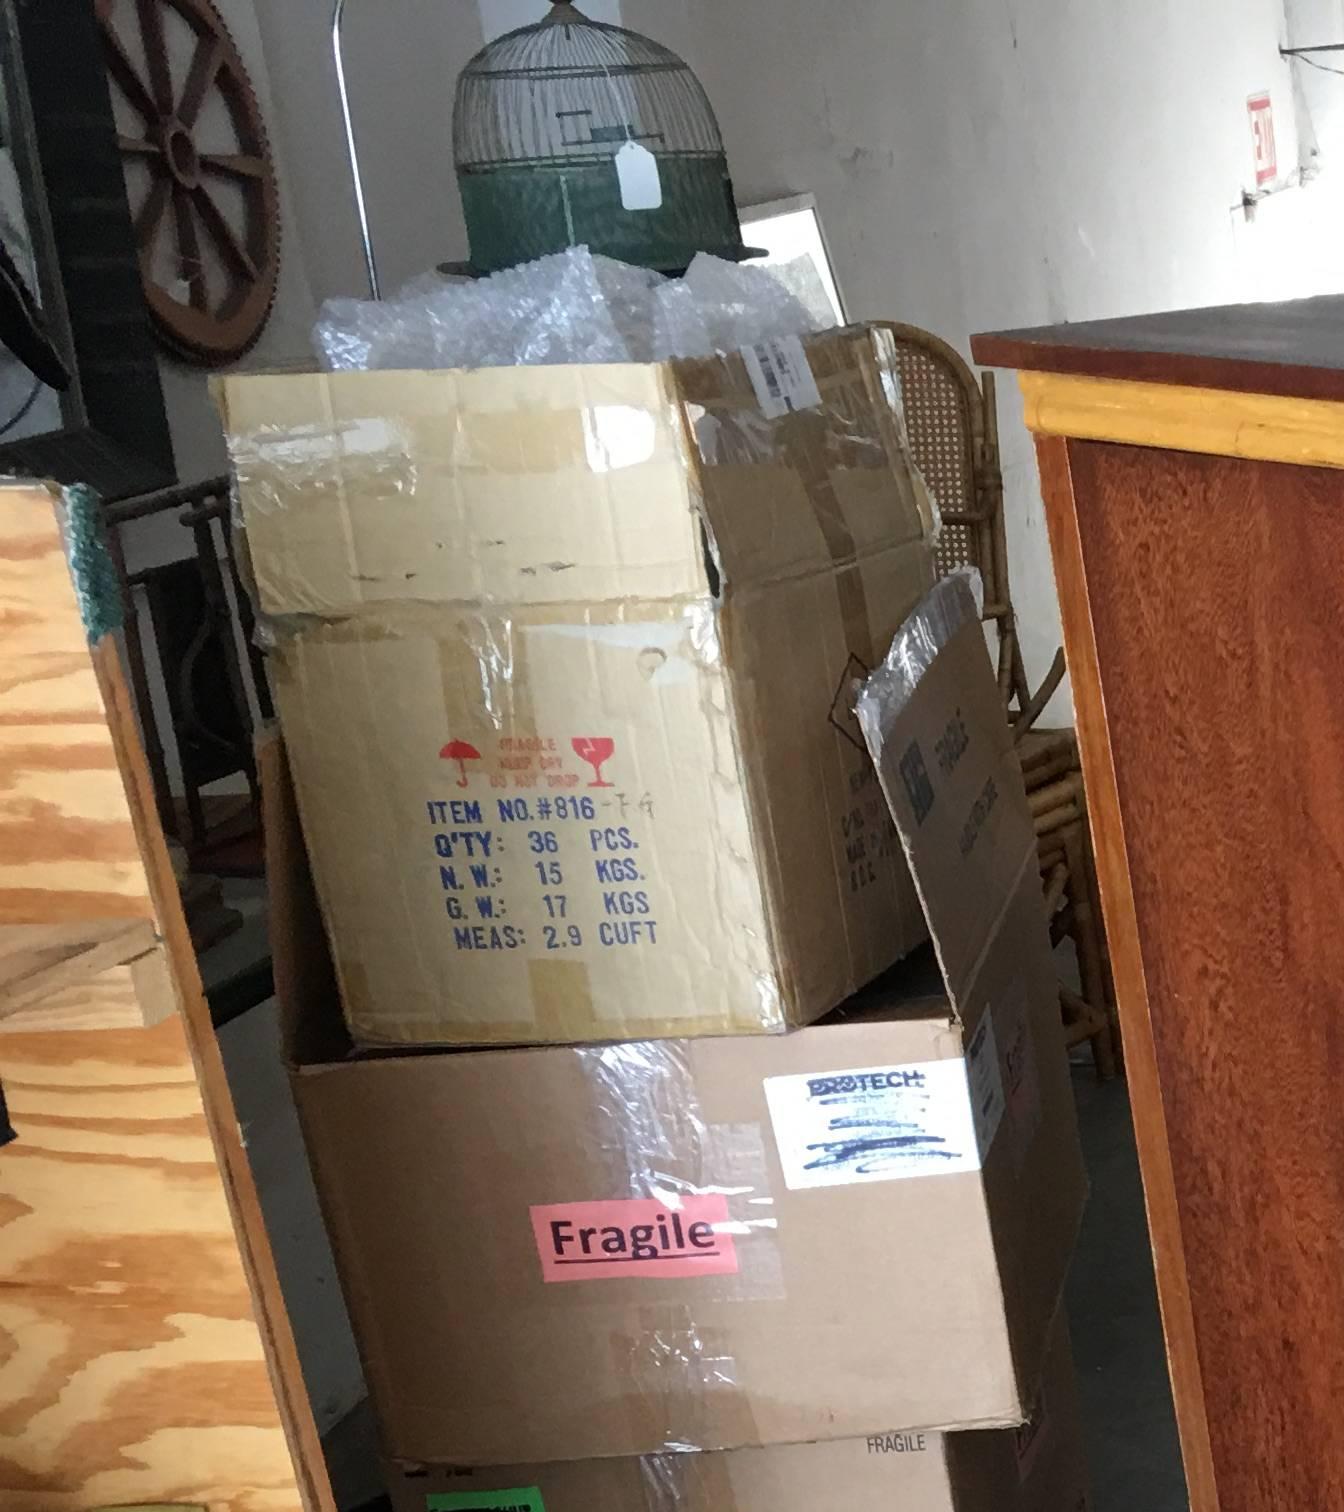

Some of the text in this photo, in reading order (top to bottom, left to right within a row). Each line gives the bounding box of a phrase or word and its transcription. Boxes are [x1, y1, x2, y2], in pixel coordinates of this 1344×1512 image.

[426, 795, 596, 825] ITEM NO.#816
[433, 826, 640, 859] Q'TY: 36 PCS.
[533, 860, 563, 886] 15
[594, 857, 646, 884] KGS.
[542, 893, 567, 919] 17
[602, 890, 651, 916] KGS
[453, 920, 658, 951] MEAS: 2.9 CUFT
[549, 1212, 716, 1261] Fragile
[866, 1433, 927, 1454] FRAGILE
